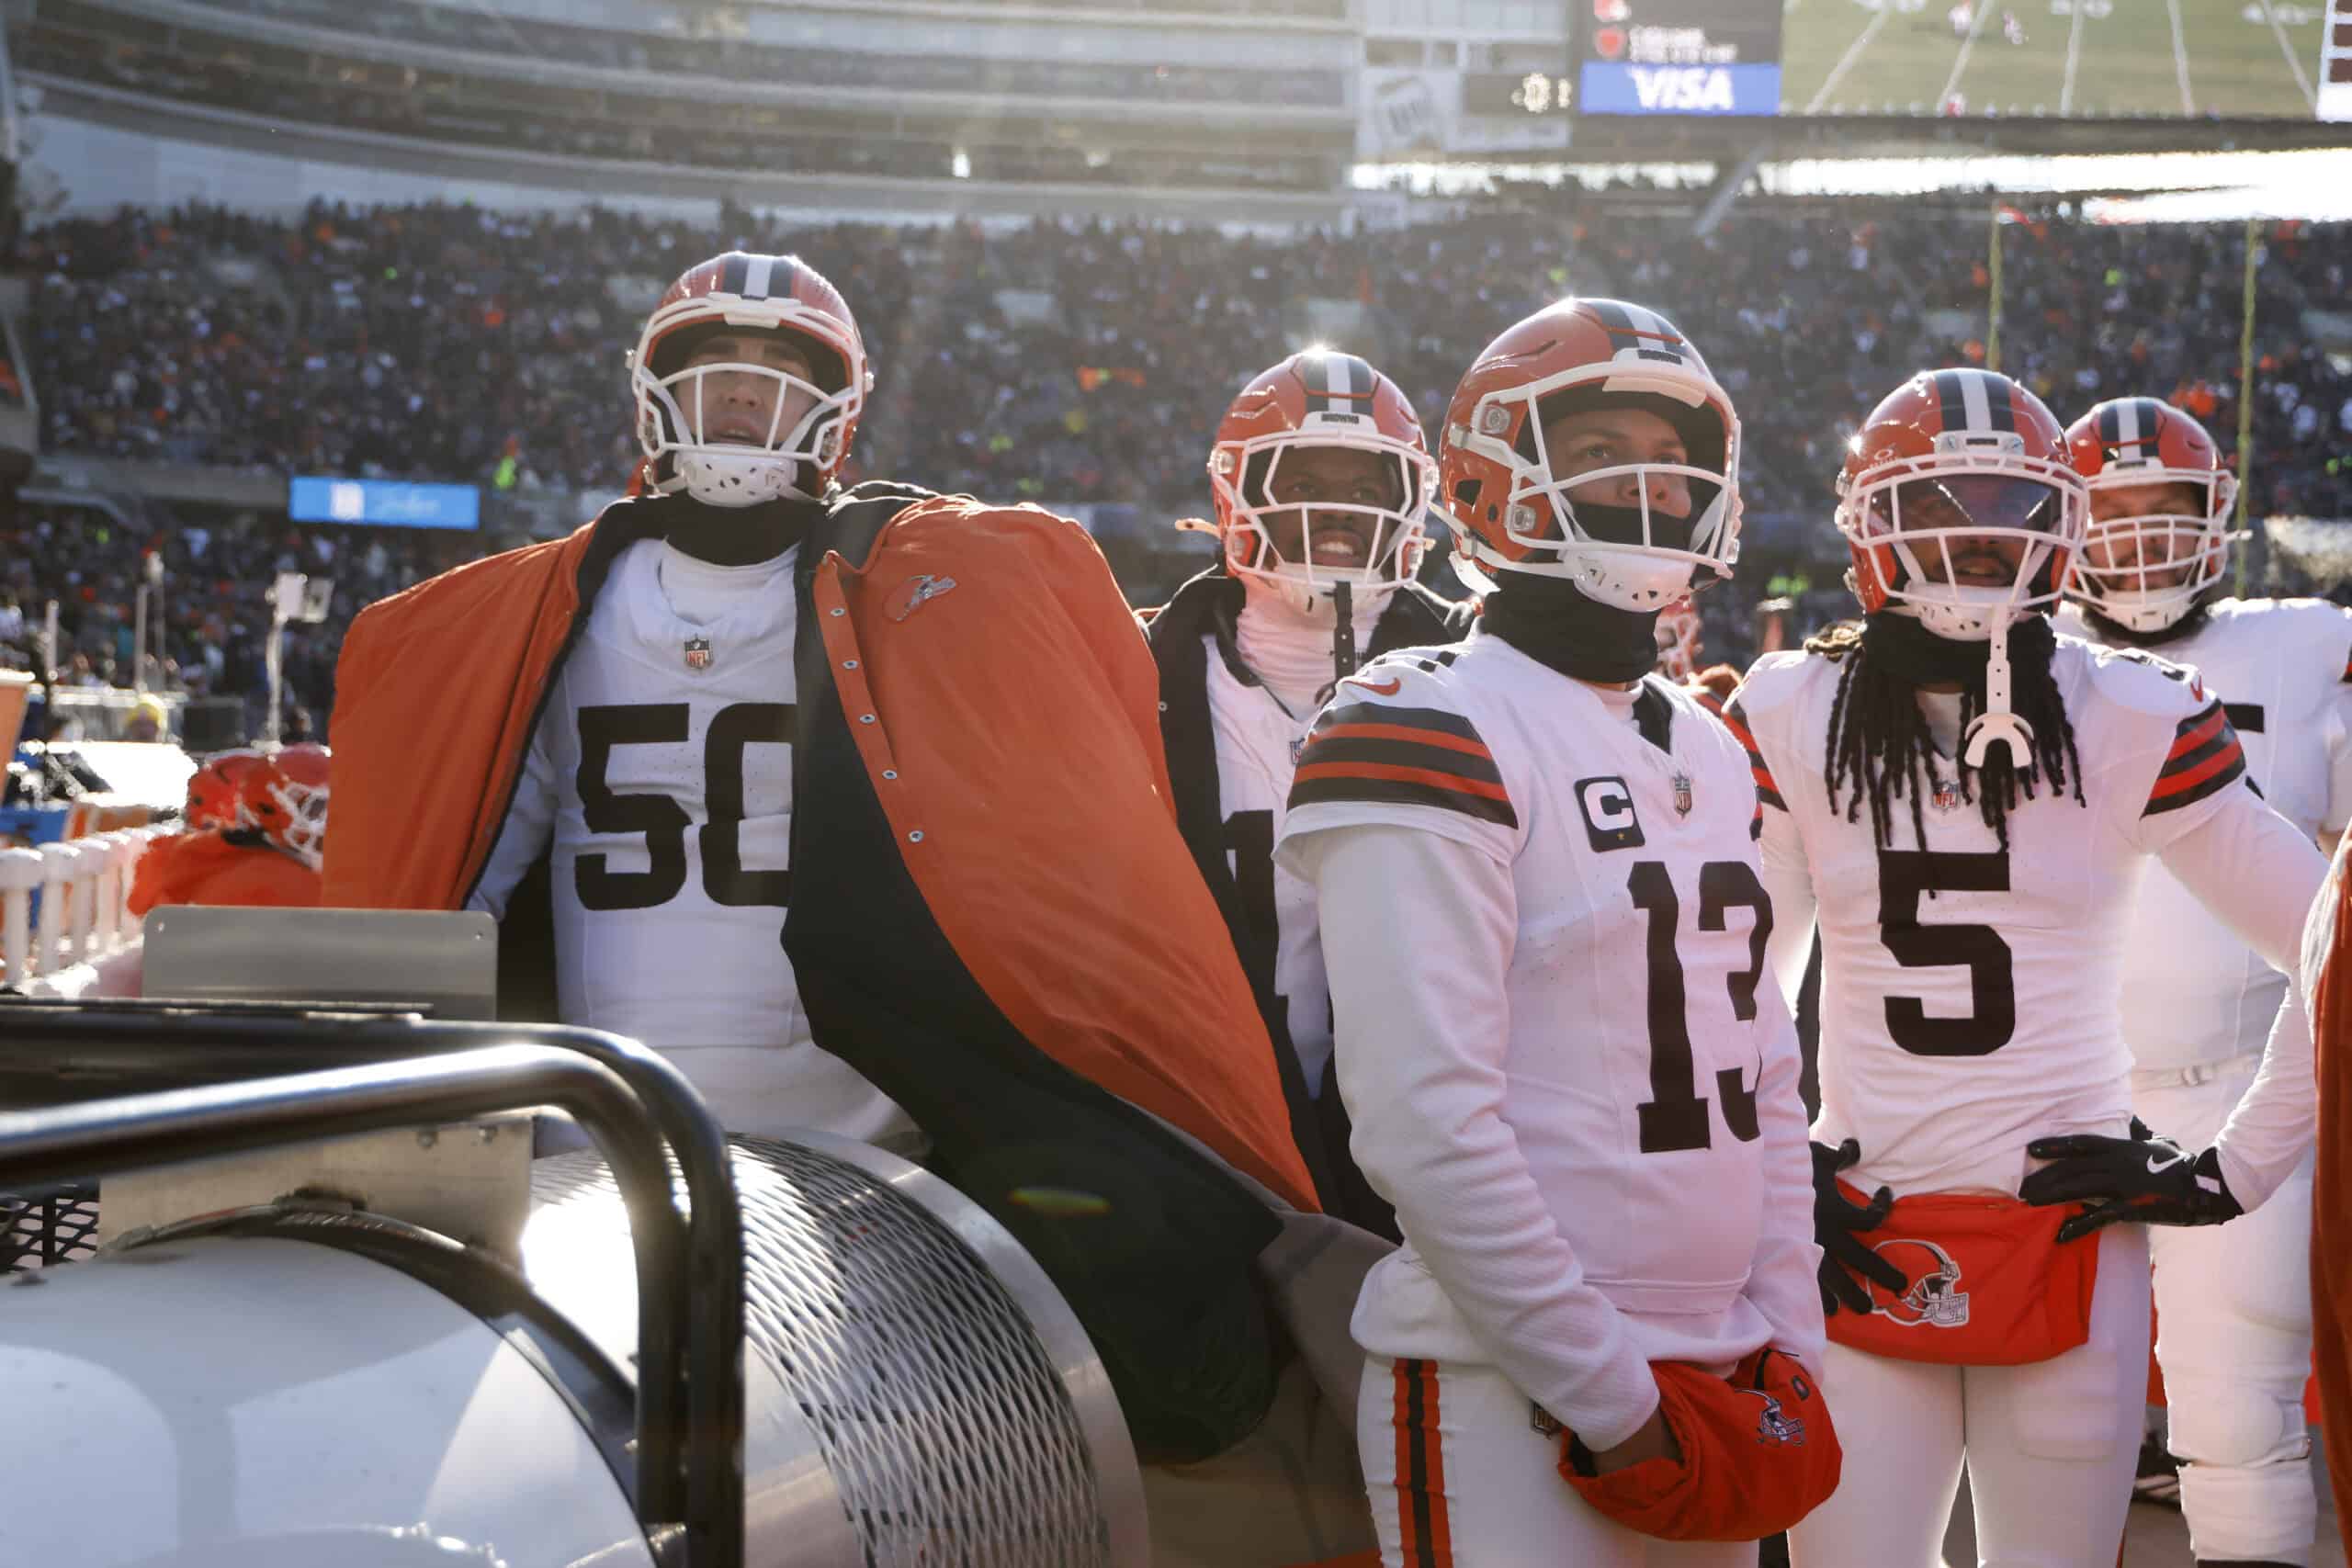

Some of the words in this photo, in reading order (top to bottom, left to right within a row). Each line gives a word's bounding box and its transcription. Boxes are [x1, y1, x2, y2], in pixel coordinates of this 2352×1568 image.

[1627, 68, 1734, 110] VISA
[576, 704, 797, 910] 50
[1585, 782, 1633, 830] C
[1627, 861, 1773, 1153] 13
[1879, 851, 2015, 1055] 5
